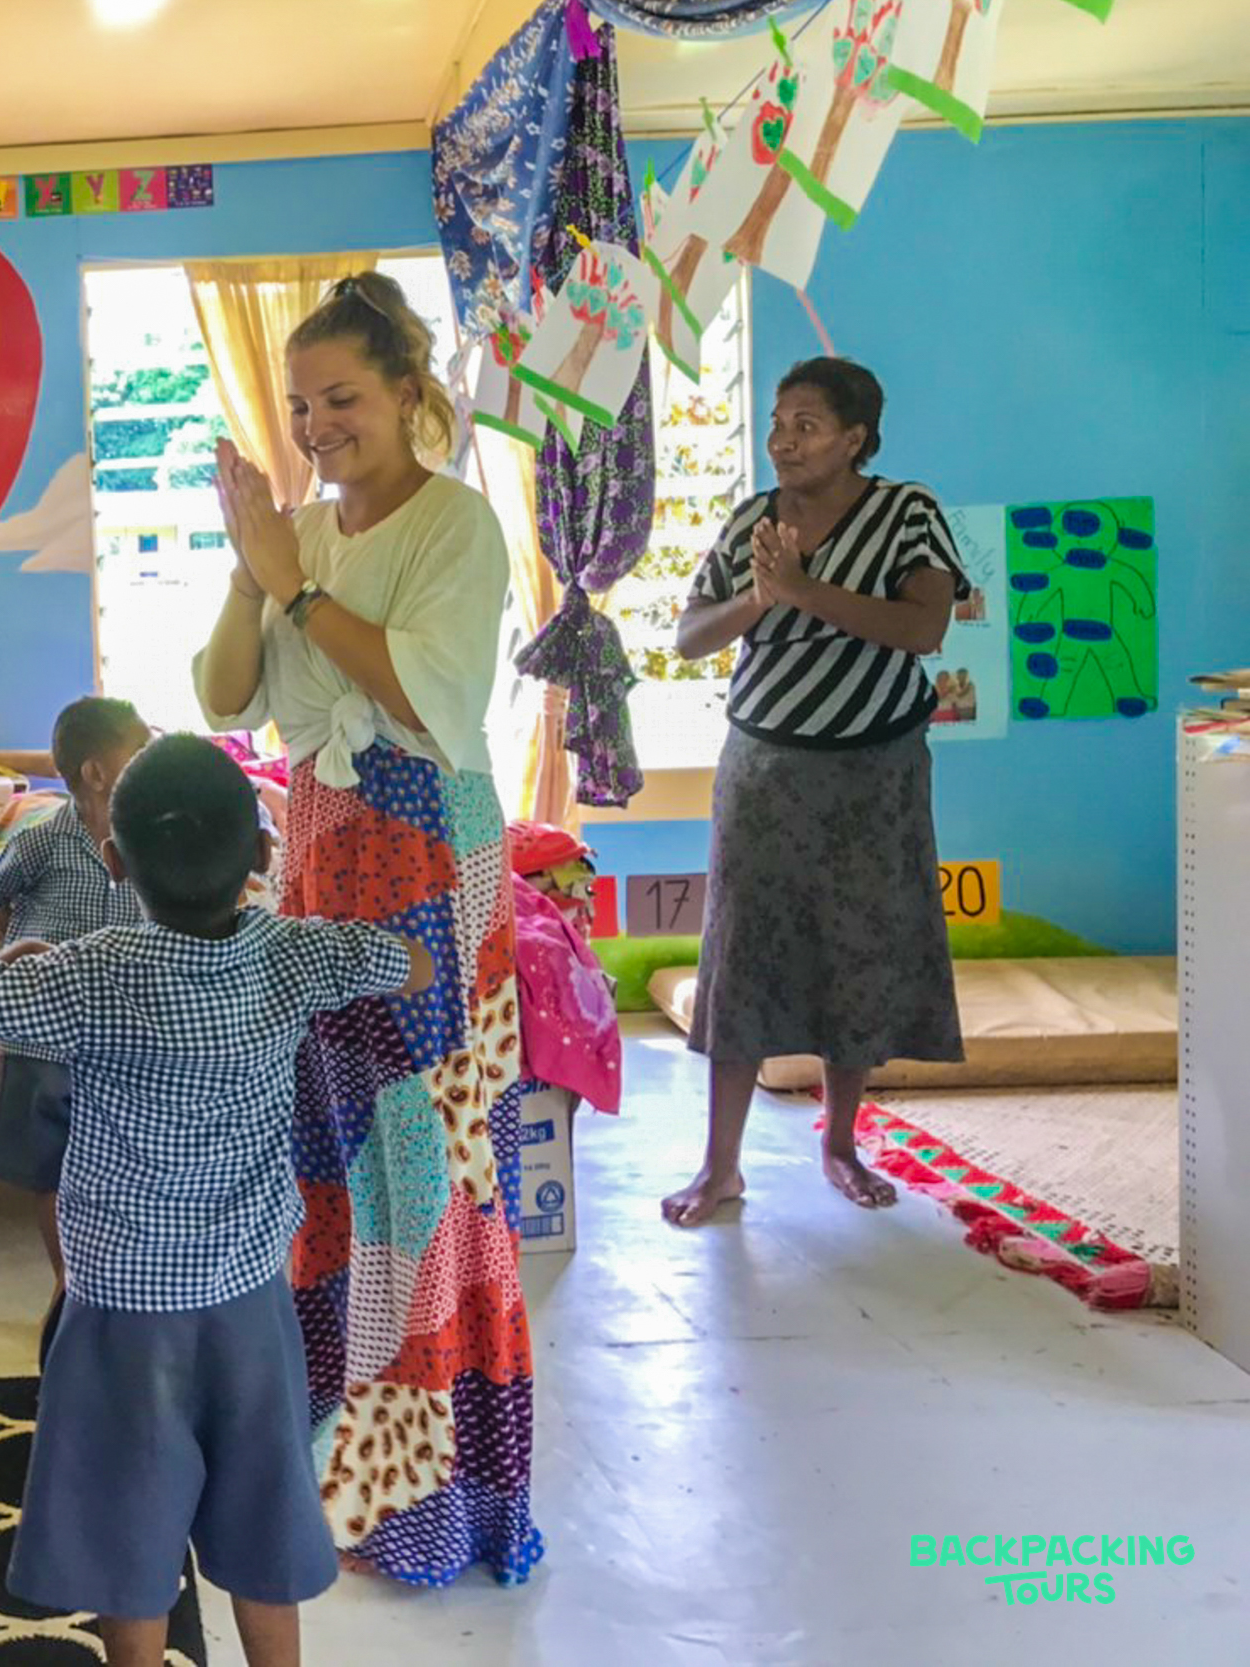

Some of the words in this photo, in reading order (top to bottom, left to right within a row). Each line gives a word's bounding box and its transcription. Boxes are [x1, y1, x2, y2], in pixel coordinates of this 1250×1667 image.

[86, 173, 105, 204] Y
[133, 170, 155, 200] Z
[645, 879, 691, 930] 17
